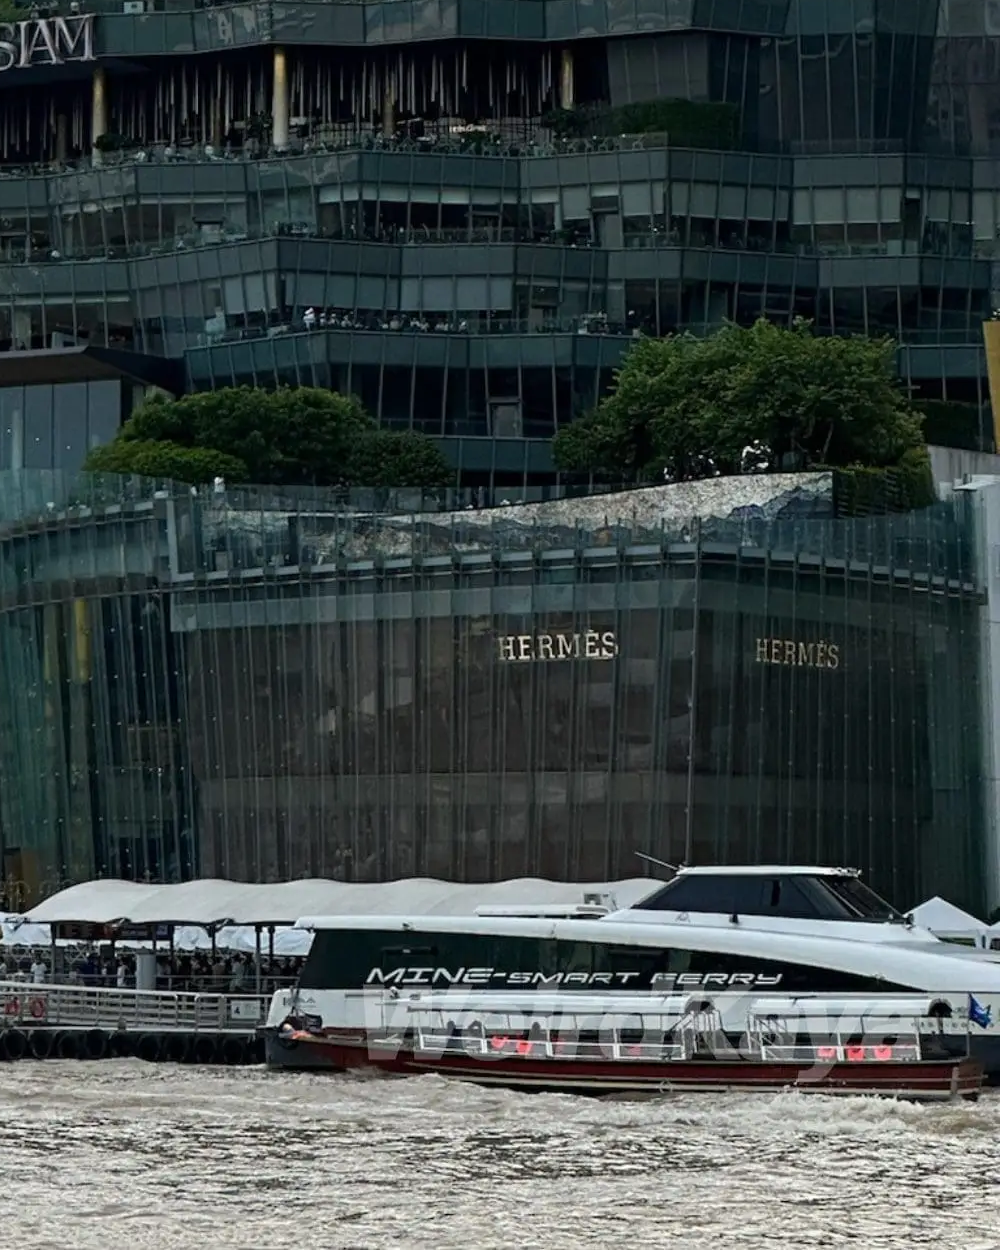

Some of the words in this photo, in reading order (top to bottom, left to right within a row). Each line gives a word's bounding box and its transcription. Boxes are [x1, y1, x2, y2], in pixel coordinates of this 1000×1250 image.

[498, 630, 619, 661] HERMÈS
[366, 967, 640, 985] MINE-SMART
[650, 972, 784, 986] FERRY
